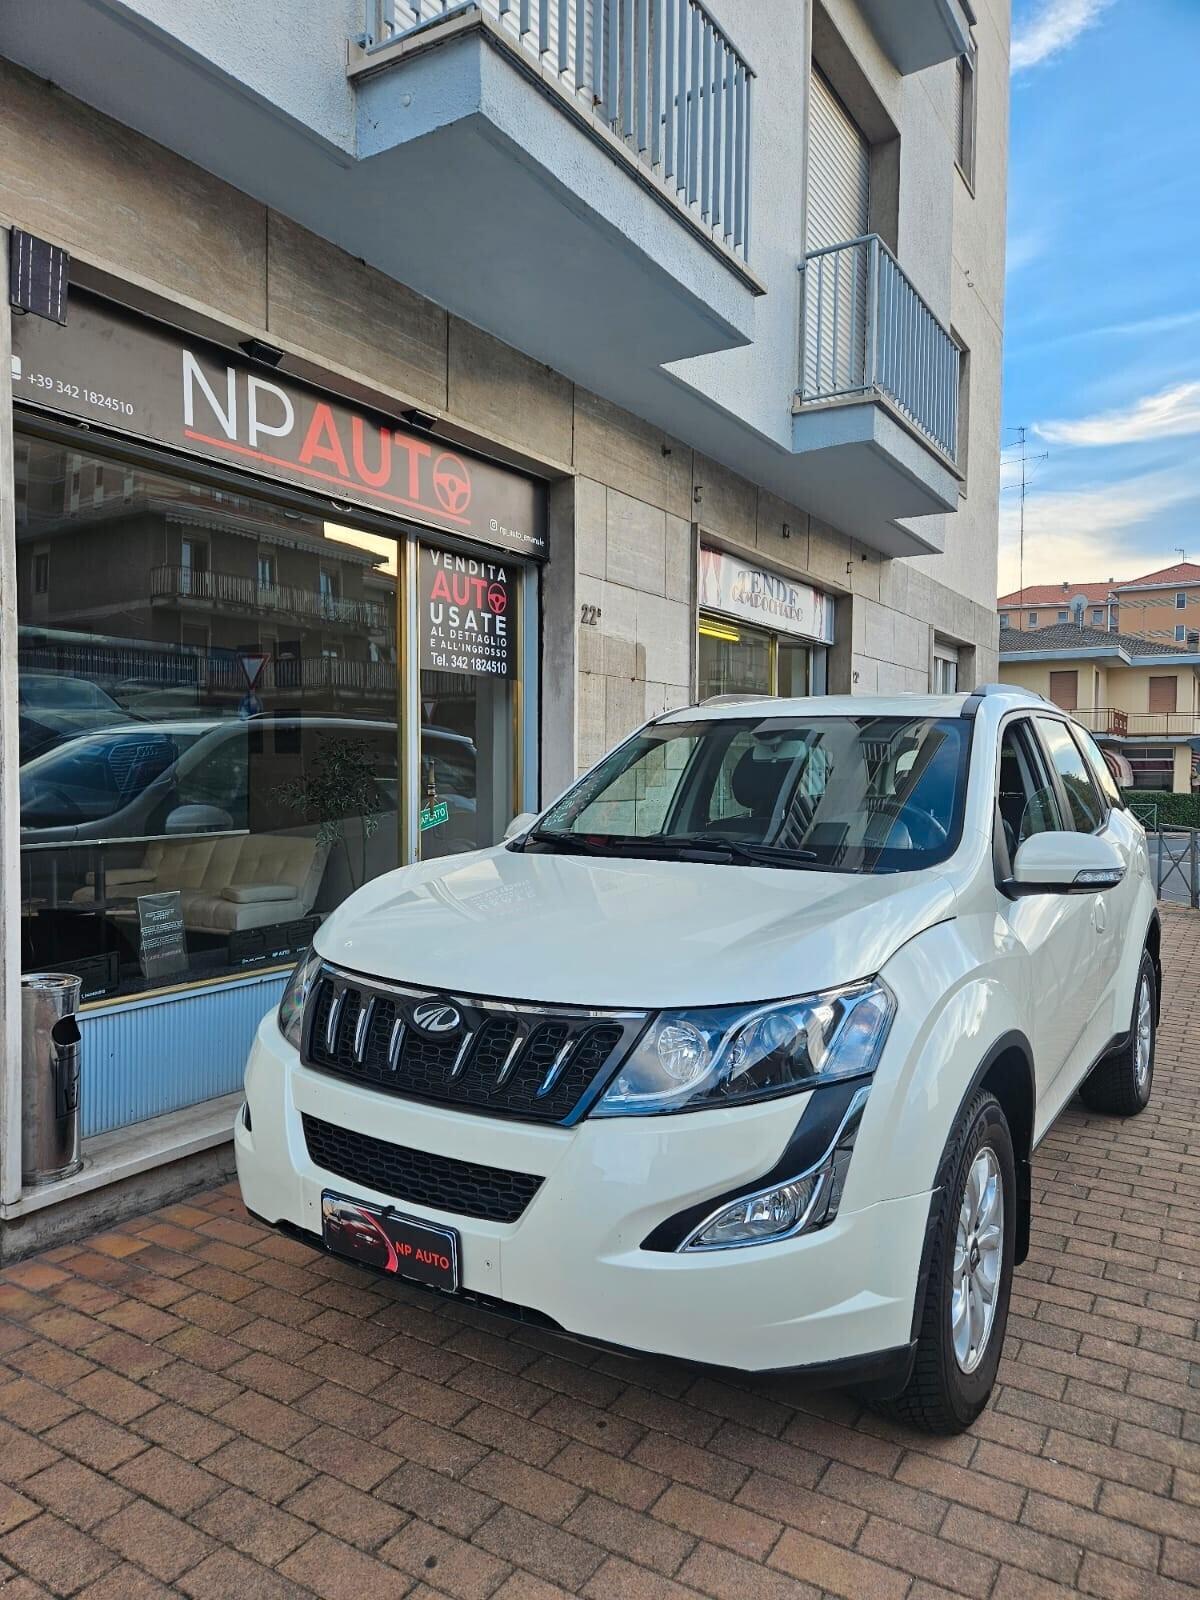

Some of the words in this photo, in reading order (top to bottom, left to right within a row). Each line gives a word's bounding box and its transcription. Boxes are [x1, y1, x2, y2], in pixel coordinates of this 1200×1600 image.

[27, 373, 53, 389] +39
[56, 380, 79, 399] 342
[83, 389, 134, 415] 1824510
[430, 549, 507, 583] VENDITA
[737, 570, 799, 608] TENDE
[430, 602, 507, 636] USATE
[430, 626, 445, 637] AL
[450, 629, 507, 647] DETTAGLIO
[430, 638, 436, 647] E
[440, 640, 507, 658] ALL'INGROSSO
[430, 651, 449, 667] Tel.
[451, 655, 468, 669] 342
[470, 657, 507, 675] 1824510
[395, 1241, 412, 1256] NP
[416, 1248, 450, 1270] AUTO
